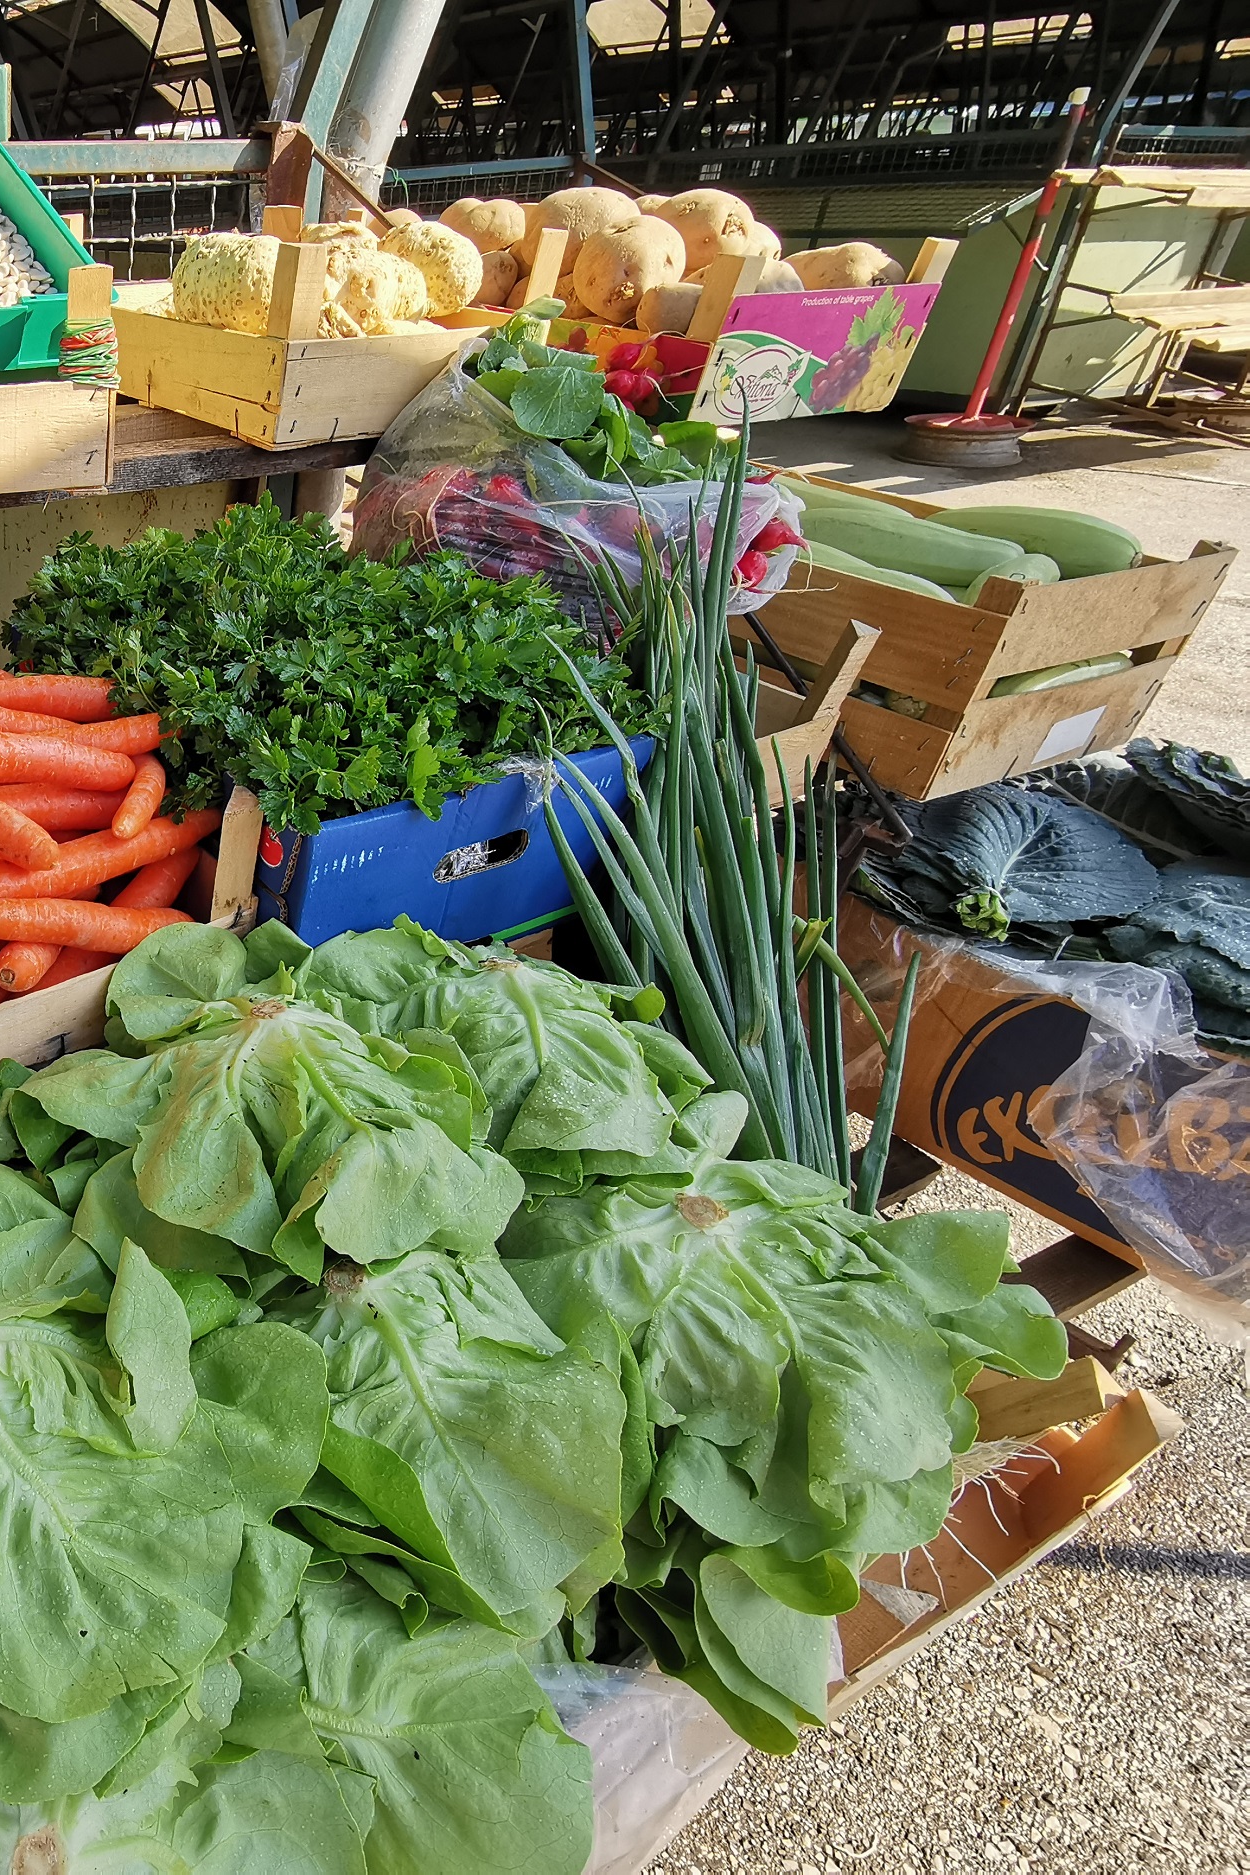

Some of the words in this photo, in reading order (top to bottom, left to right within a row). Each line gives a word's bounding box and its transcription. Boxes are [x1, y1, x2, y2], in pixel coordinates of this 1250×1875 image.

[801, 296, 833, 306] Production
[833, 295, 841, 305] of
[840, 295, 854, 304] table
[853, 294, 875, 305] grapes
